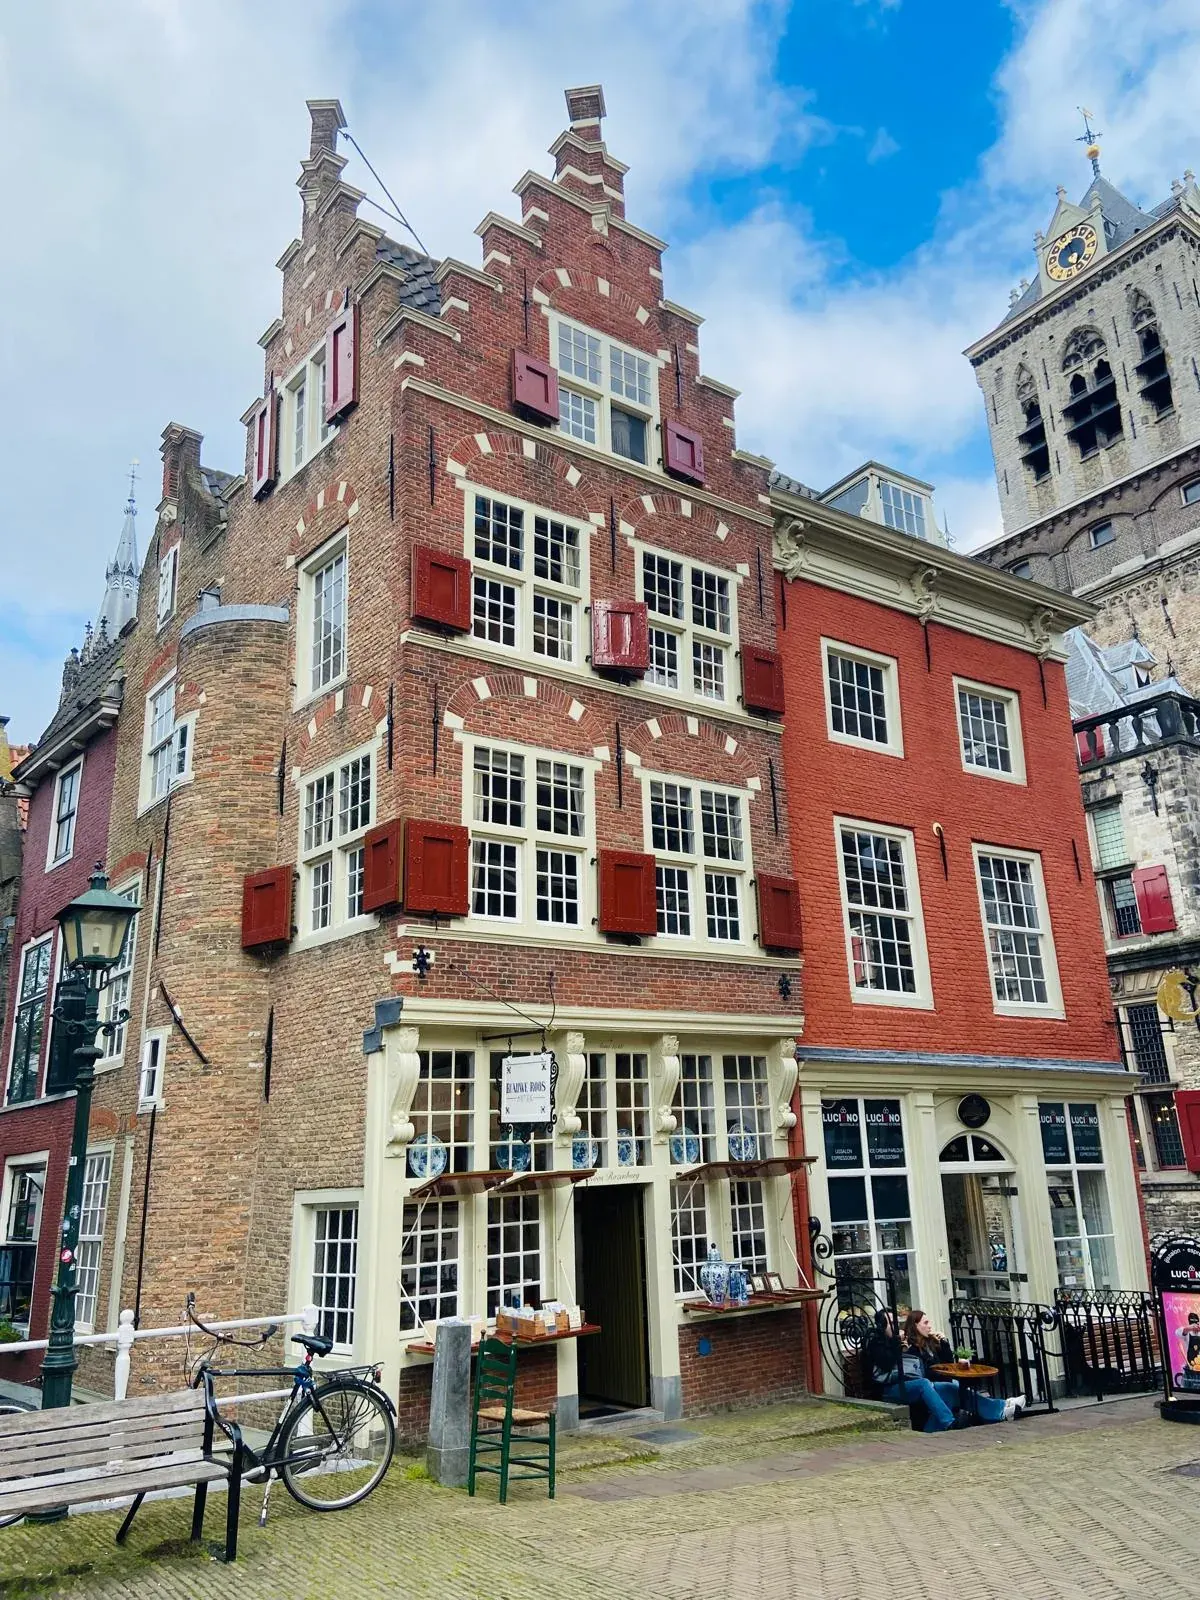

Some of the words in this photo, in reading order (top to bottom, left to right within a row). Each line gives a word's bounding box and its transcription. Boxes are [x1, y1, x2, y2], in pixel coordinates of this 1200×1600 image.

[823, 1113, 858, 1123] LUCIANO
[866, 1113, 901, 1123] LUCIANO
[1071, 1116, 1098, 1125] LUCIANO
